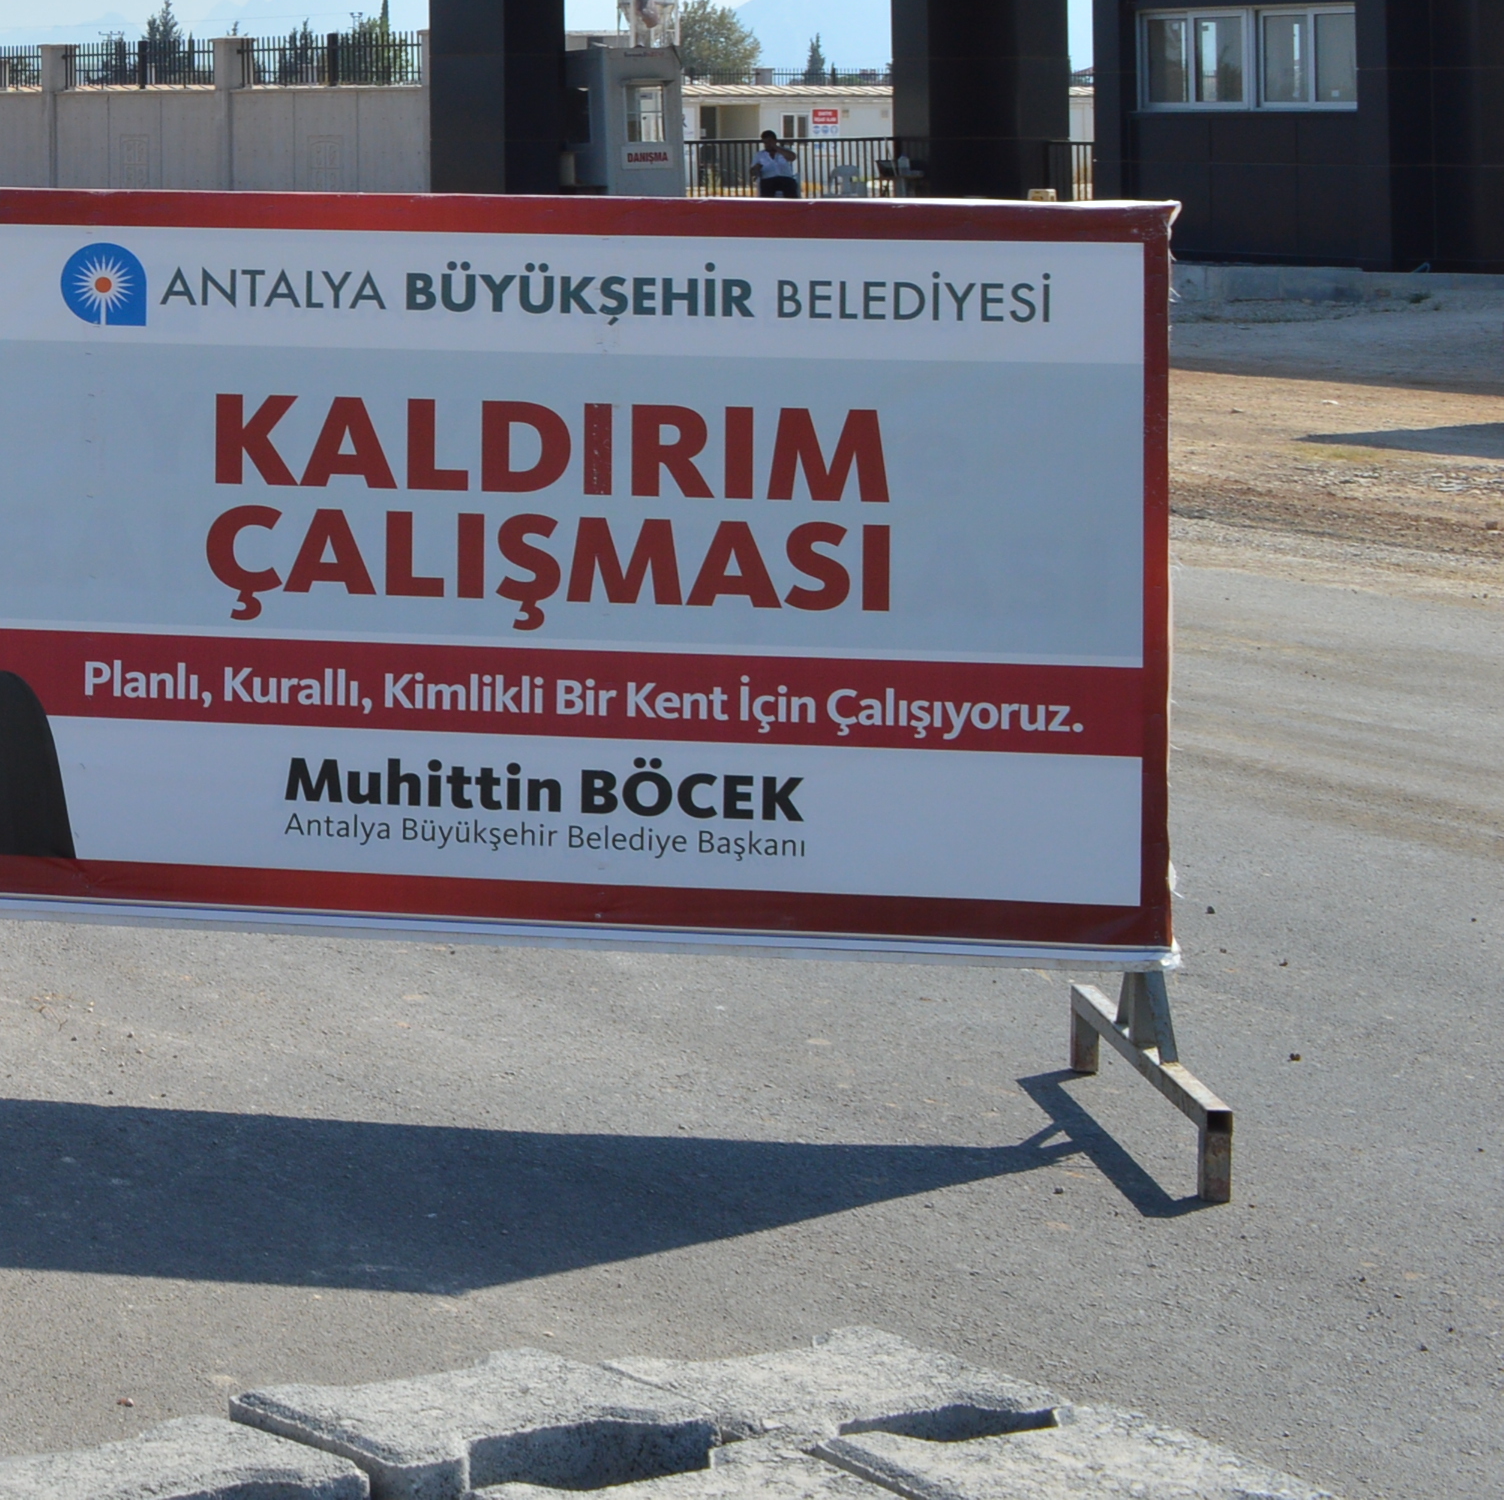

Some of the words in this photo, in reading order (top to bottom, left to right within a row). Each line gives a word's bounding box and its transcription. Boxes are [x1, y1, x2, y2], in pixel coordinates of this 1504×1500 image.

[627, 152, 669, 164] DANIŞMA
[159, 265, 387, 310] ANTALYA
[405, 260, 755, 326] BÜYÜKŞEHİR
[776, 271, 1052, 323] BELEDİYESİ
[215, 393, 891, 503] KALDIRIM
[205, 504, 891, 631] ÇALIŞMASI
[84, 659, 212, 708] Planlı,
[224, 666, 373, 714] Kurallı,
[384, 672, 544, 713] Kimlikli
[555, 678, 617, 716] Bir
[626, 681, 729, 722] Kent
[739, 675, 816, 733] İçin
[826, 687, 1084, 740] Çalışıyoruz.
[284, 756, 562, 813] Muhittin
[580, 756, 805, 823] BÖCEK
[284, 812, 392, 846] Antalya
[401, 817, 558, 851] Büyükşehir
[568, 824, 688, 858] Belediye
[697, 829, 806, 862] Başkanı
